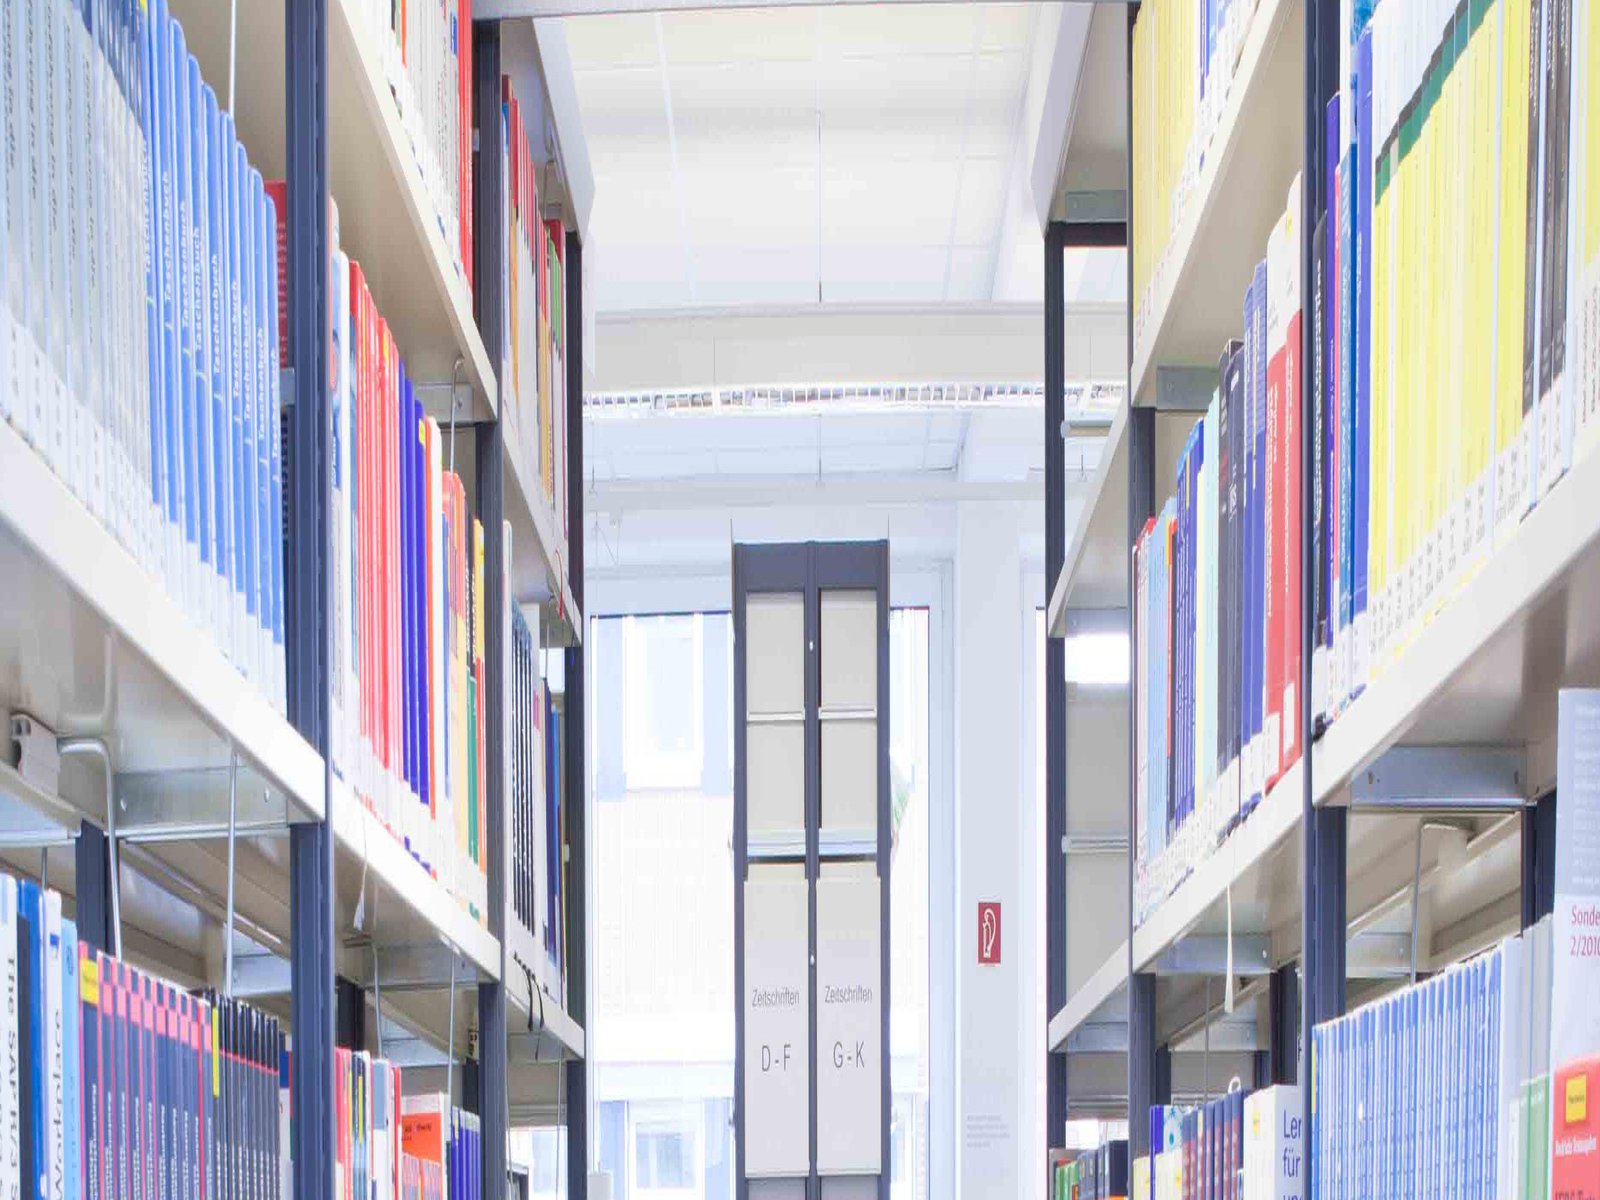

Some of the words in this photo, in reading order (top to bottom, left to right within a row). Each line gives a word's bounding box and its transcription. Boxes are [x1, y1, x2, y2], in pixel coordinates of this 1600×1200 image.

[752, 986, 800, 1008] Zeitschriften
[825, 984, 873, 1005] Zeitschriften
[761, 1044, 770, 1072] D
[783, 1043, 792, 1071] F
[833, 1040, 843, 1070] G
[855, 1040, 865, 1069] K
[1283, 1146, 1301, 1178] für
